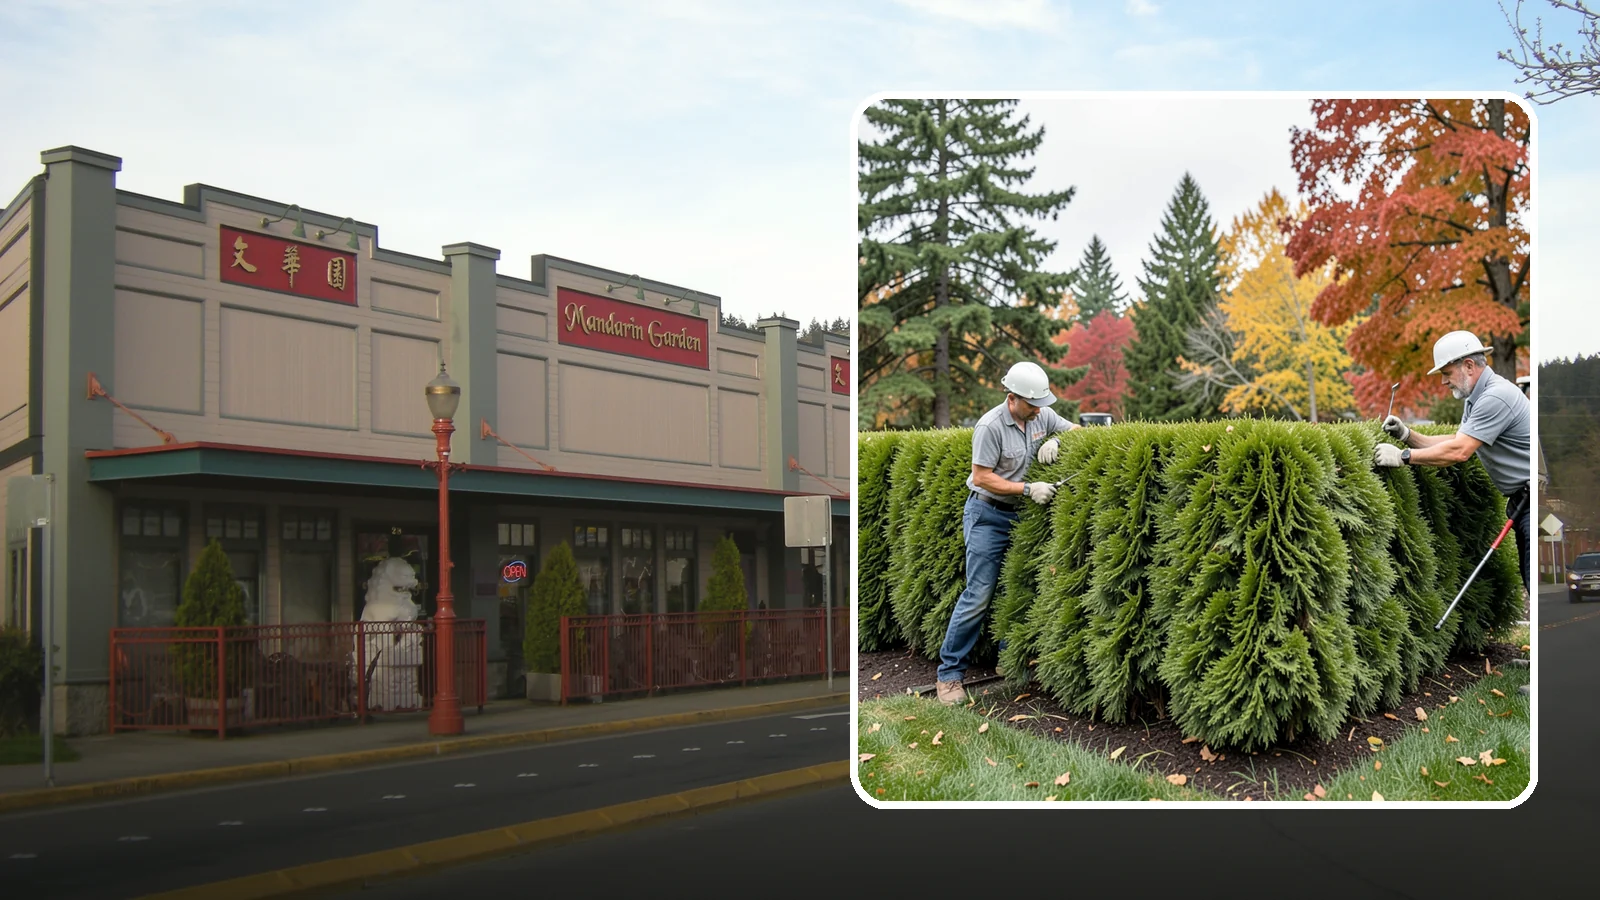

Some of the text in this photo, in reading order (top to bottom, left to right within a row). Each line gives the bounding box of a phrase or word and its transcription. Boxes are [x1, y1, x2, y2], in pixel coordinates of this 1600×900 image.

[231, 236, 346, 291] 文華園
[564, 302, 701, 352] Mandarin Garden
[503, 565, 527, 578] OPEN
